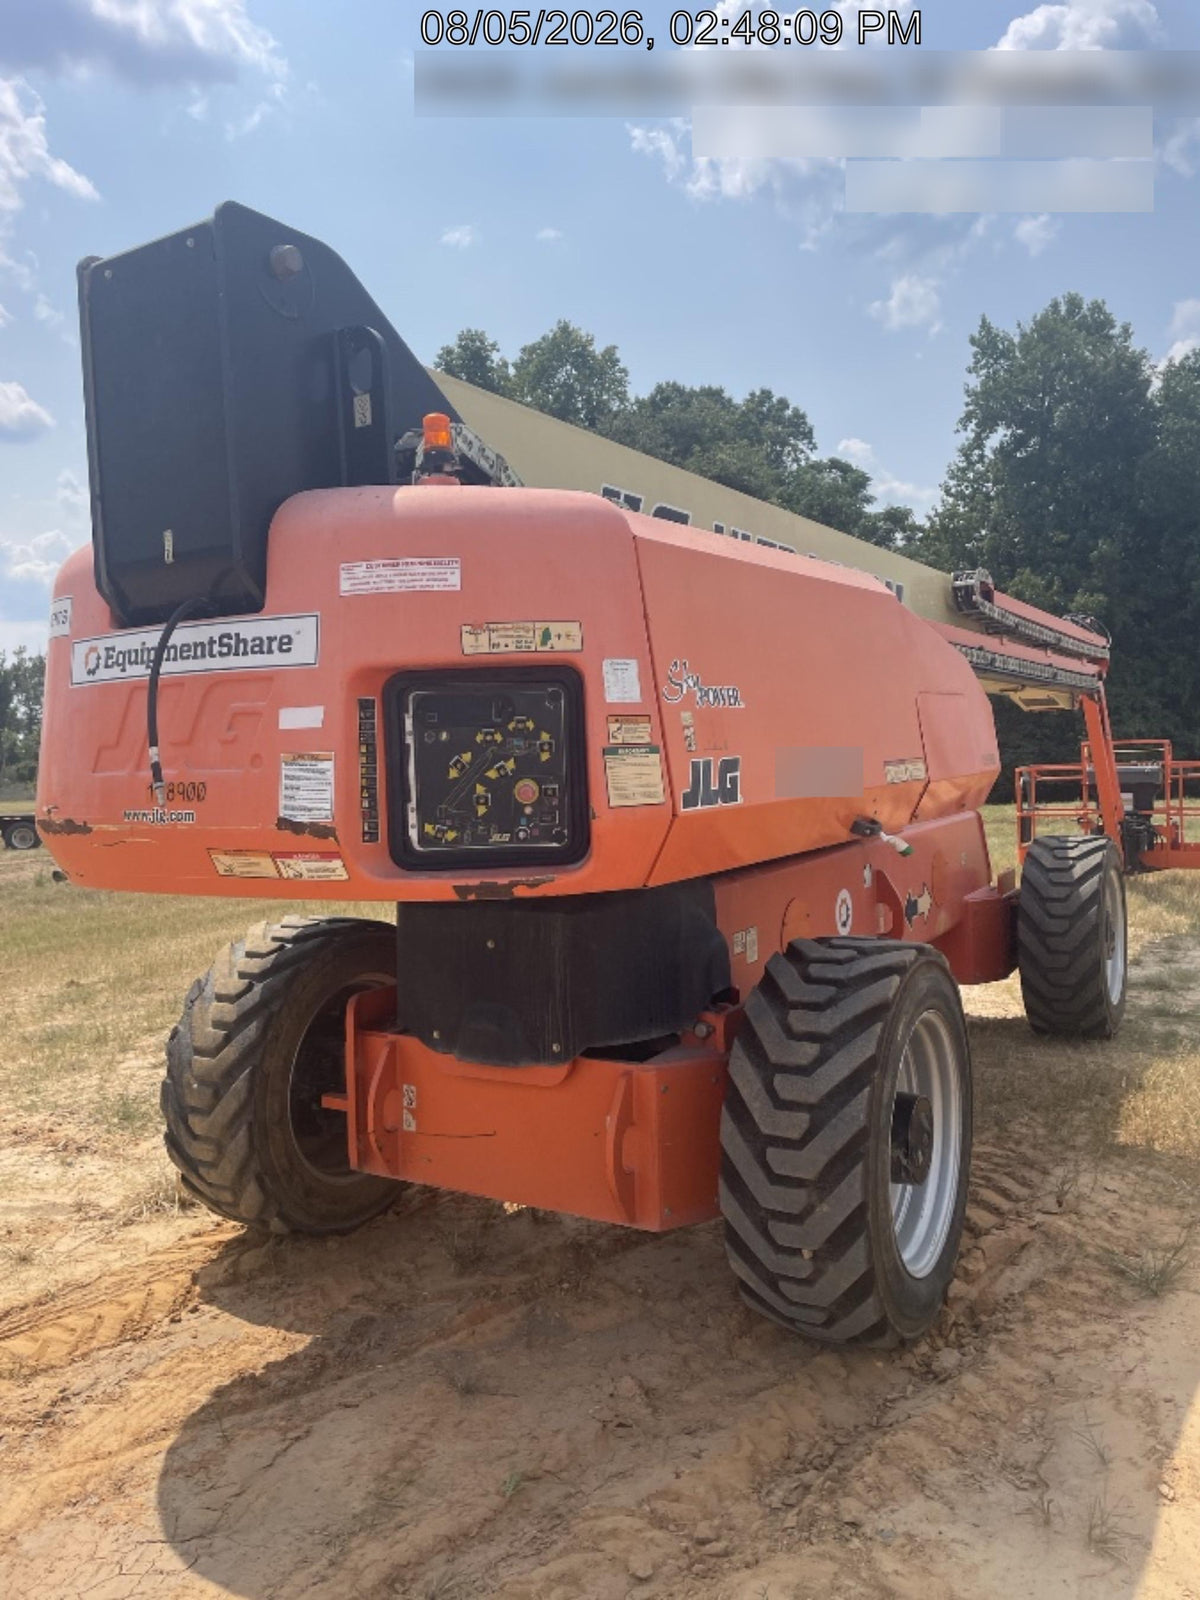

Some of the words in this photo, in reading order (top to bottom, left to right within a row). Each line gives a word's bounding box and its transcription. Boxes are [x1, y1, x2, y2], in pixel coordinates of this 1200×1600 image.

[103, 632, 293, 673] EquipmentShare
[696, 687, 743, 708] POWER
[147, 781, 207, 802] 18900
[681, 756, 742, 810] JLG
[123, 808, 195, 824] www.jlg.com
